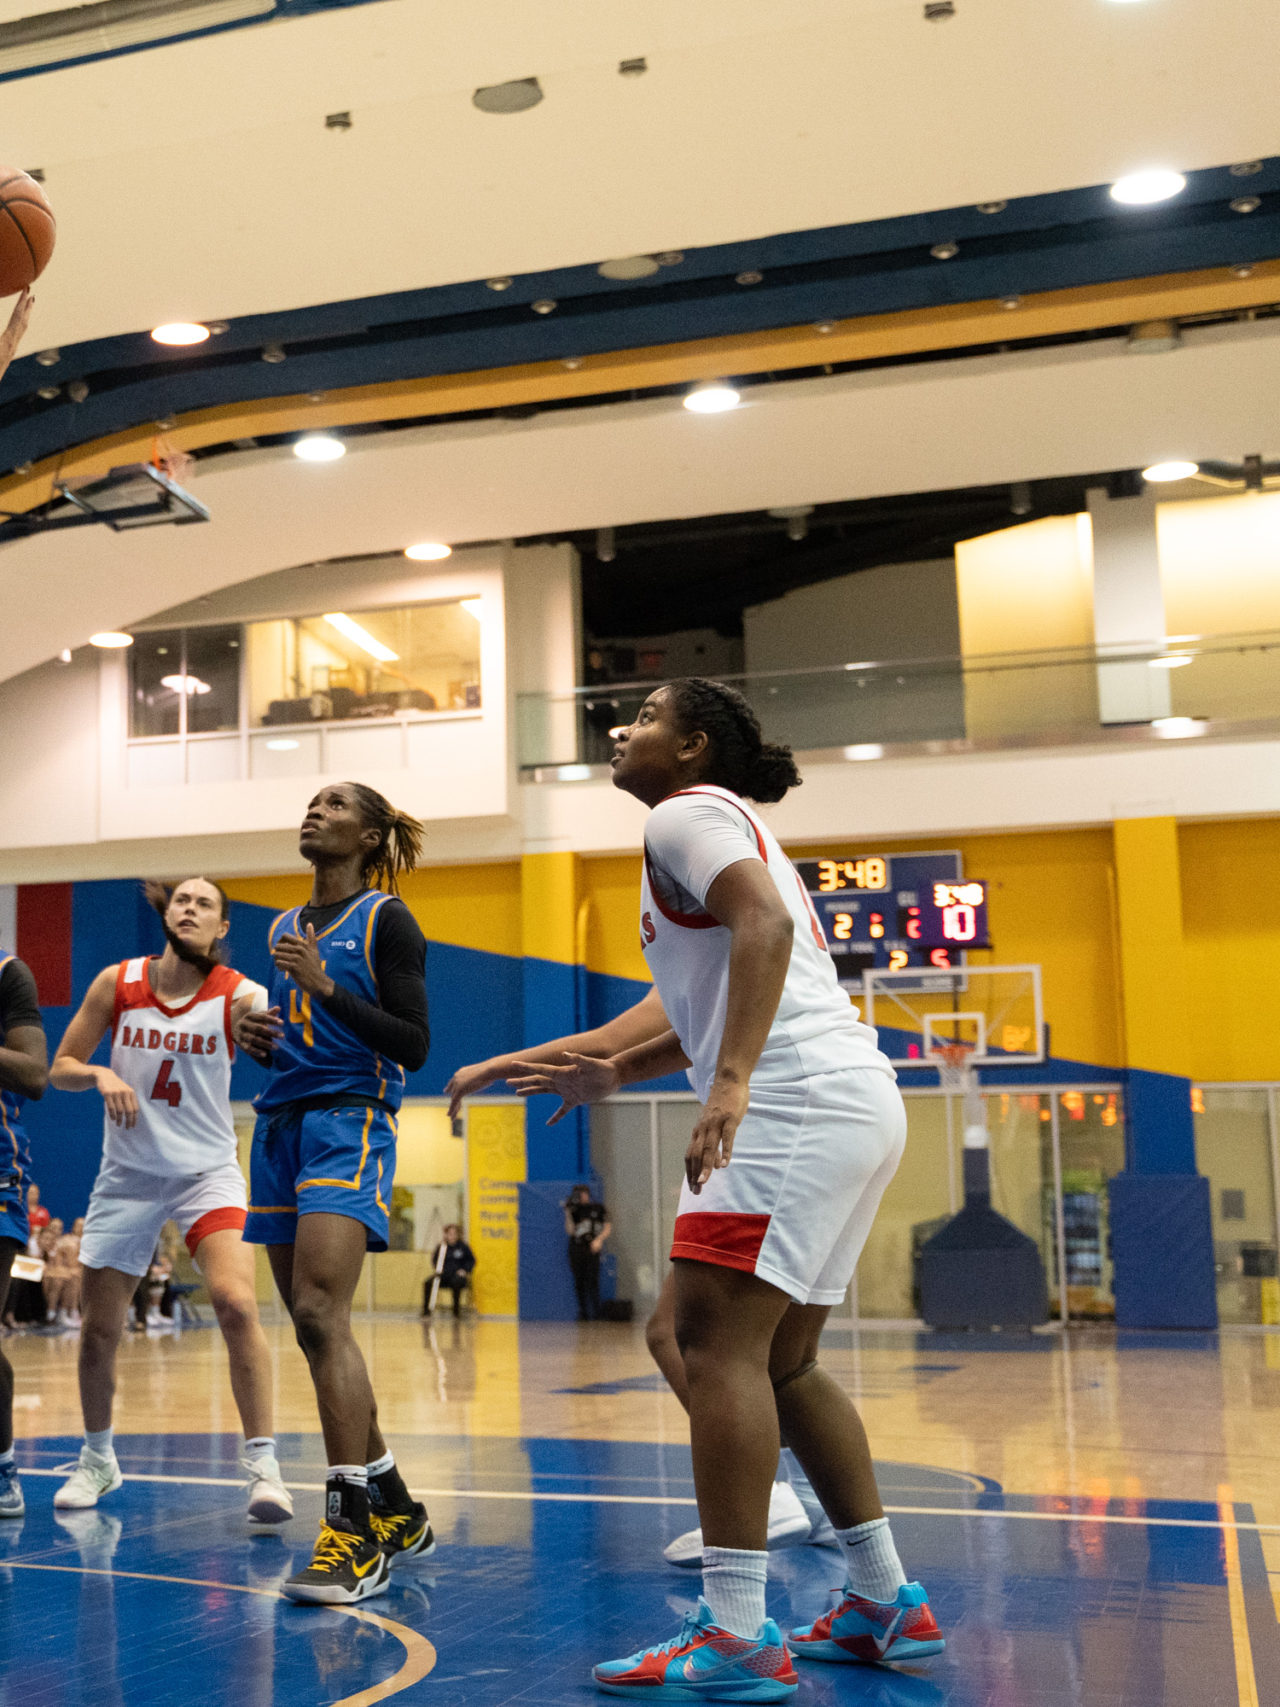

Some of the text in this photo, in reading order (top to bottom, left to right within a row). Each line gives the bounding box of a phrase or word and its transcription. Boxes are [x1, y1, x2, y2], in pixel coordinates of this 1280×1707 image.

[819, 857, 886, 891] 3:48
[833, 913, 853, 939] 2
[942, 905, 976, 940] 10
[121, 1025, 217, 1056] BADGERS
[150, 1059, 182, 1108] 4
